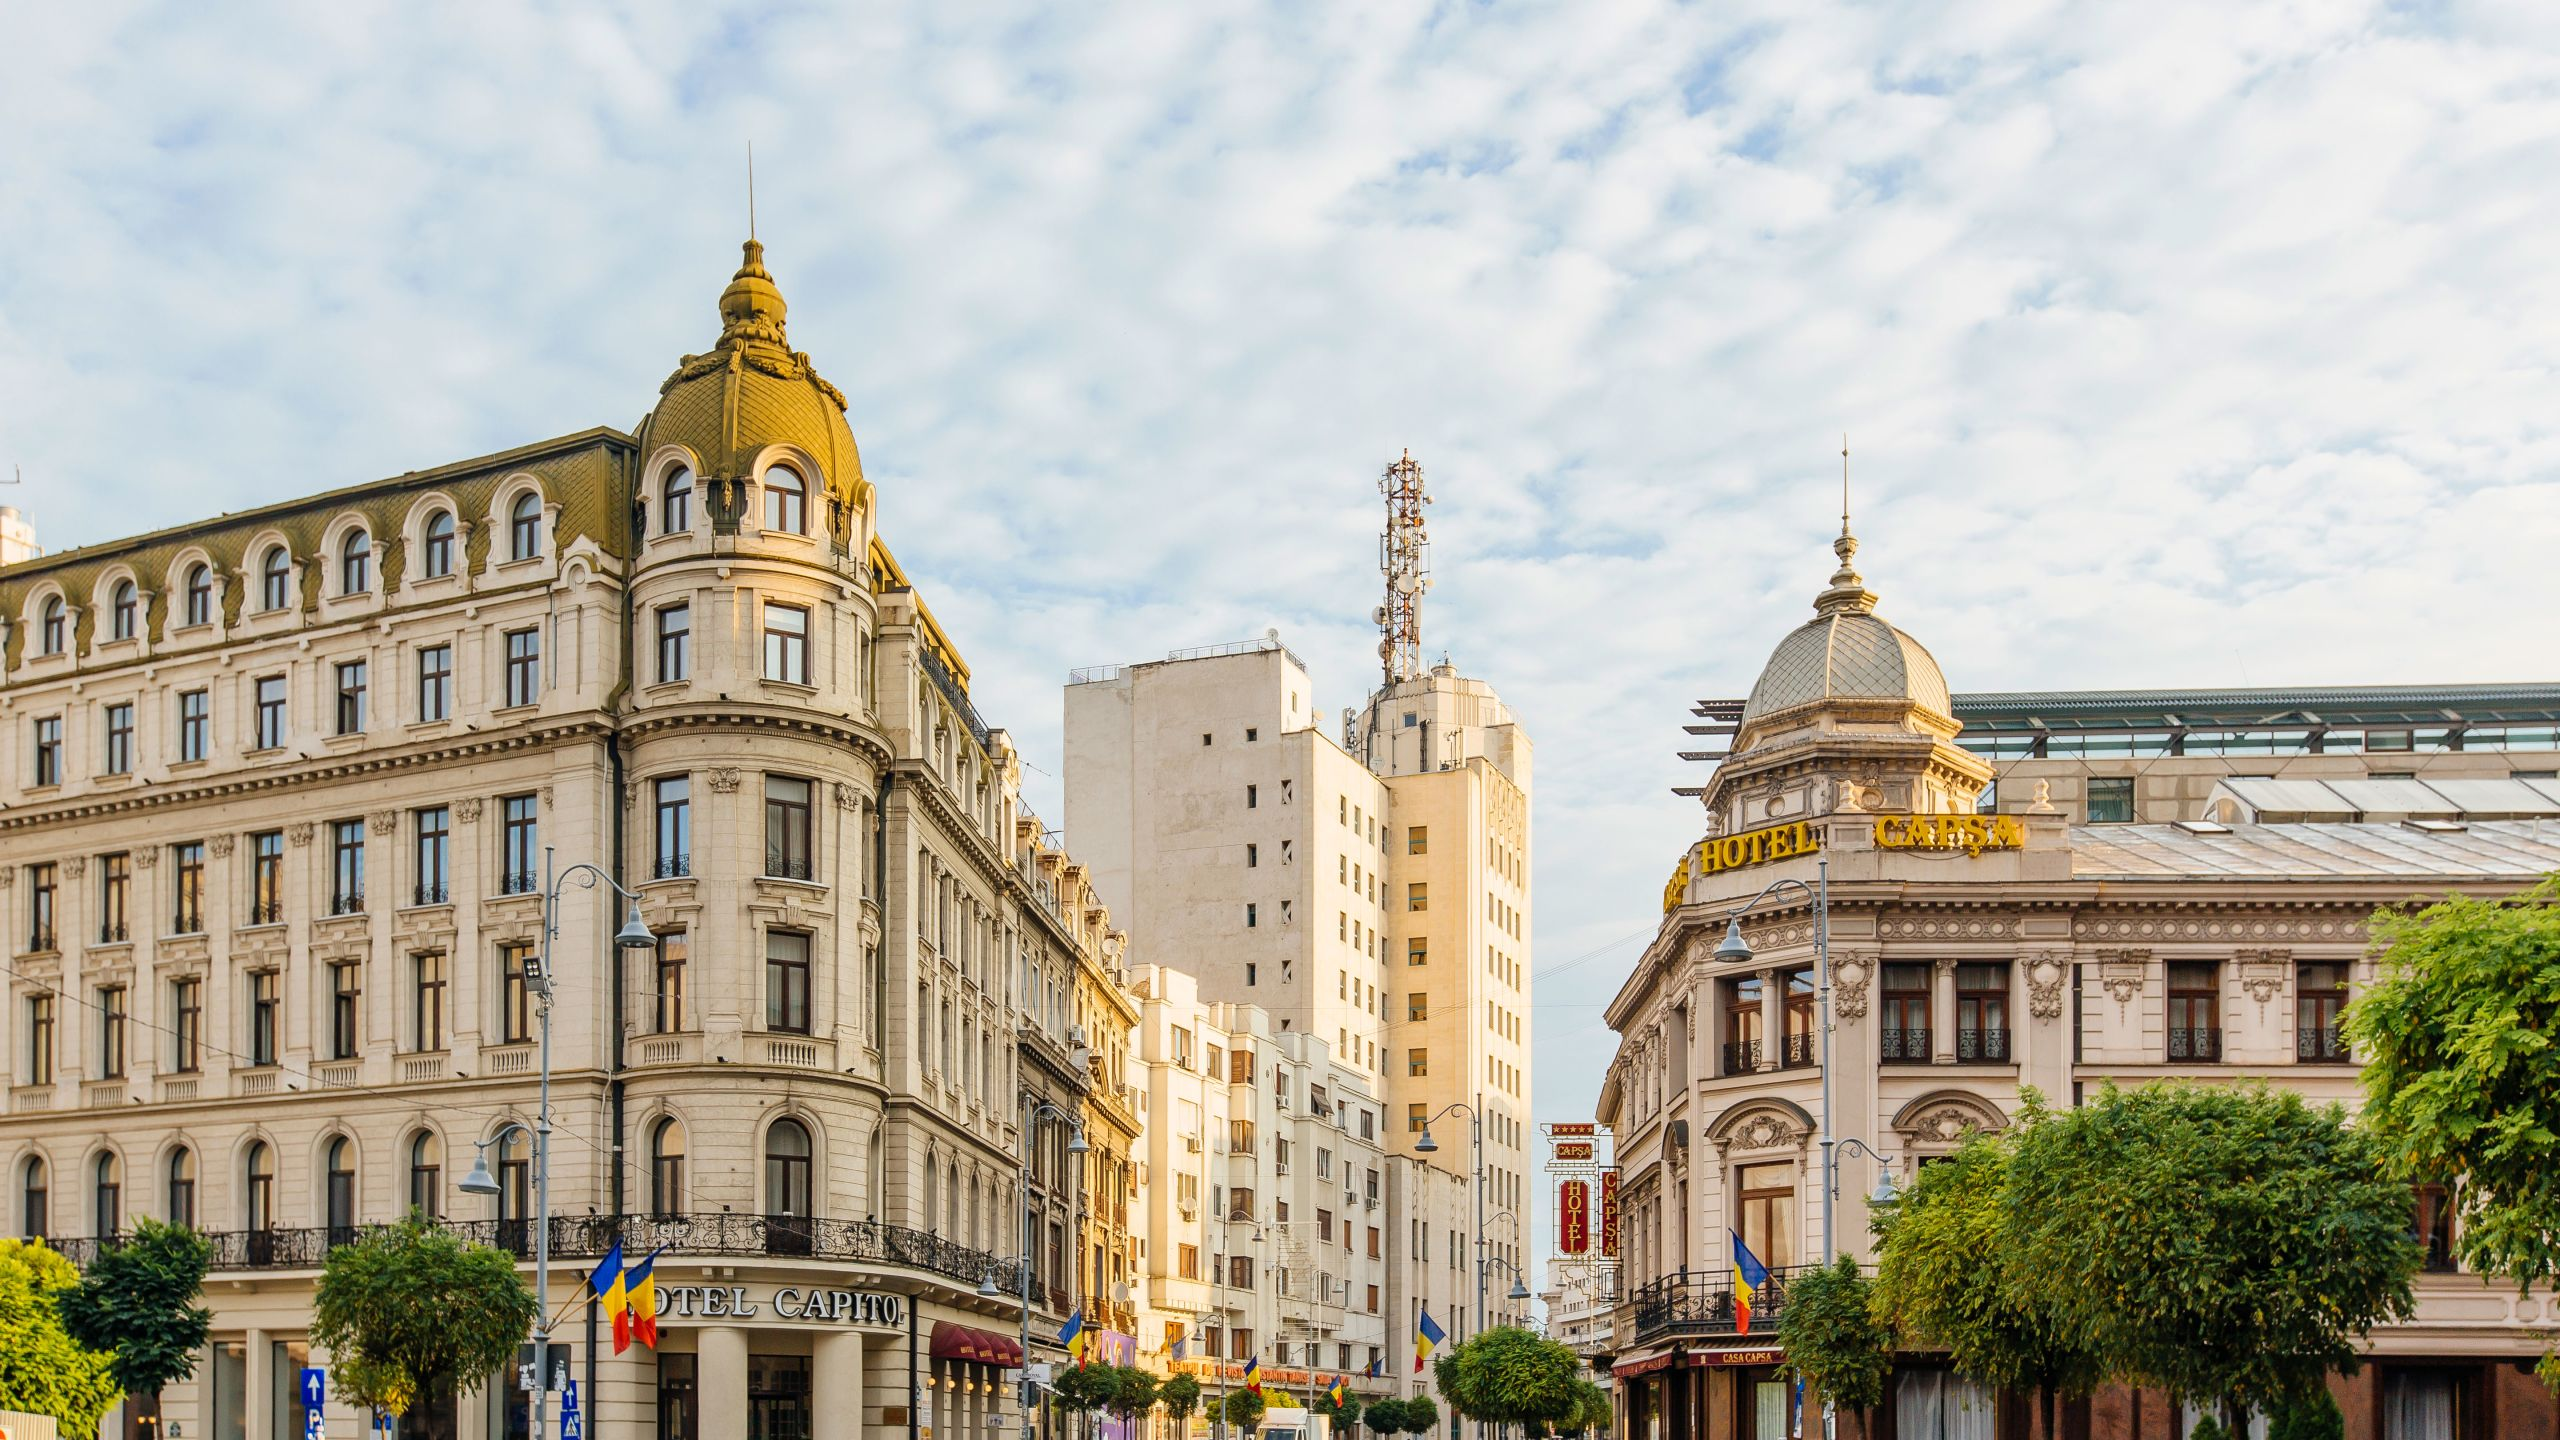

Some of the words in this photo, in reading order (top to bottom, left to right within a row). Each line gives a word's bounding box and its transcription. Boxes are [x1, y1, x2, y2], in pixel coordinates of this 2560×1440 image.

[1701, 821, 1820, 874] HOTEL
[1874, 814, 2024, 858] CAPŞA
[1568, 1181, 1581, 1253] HOTEL
[625, 1286, 758, 1317] OTEL
[774, 1288, 905, 1327] CAPITOL
[1723, 1353, 1743, 1363] CASA
